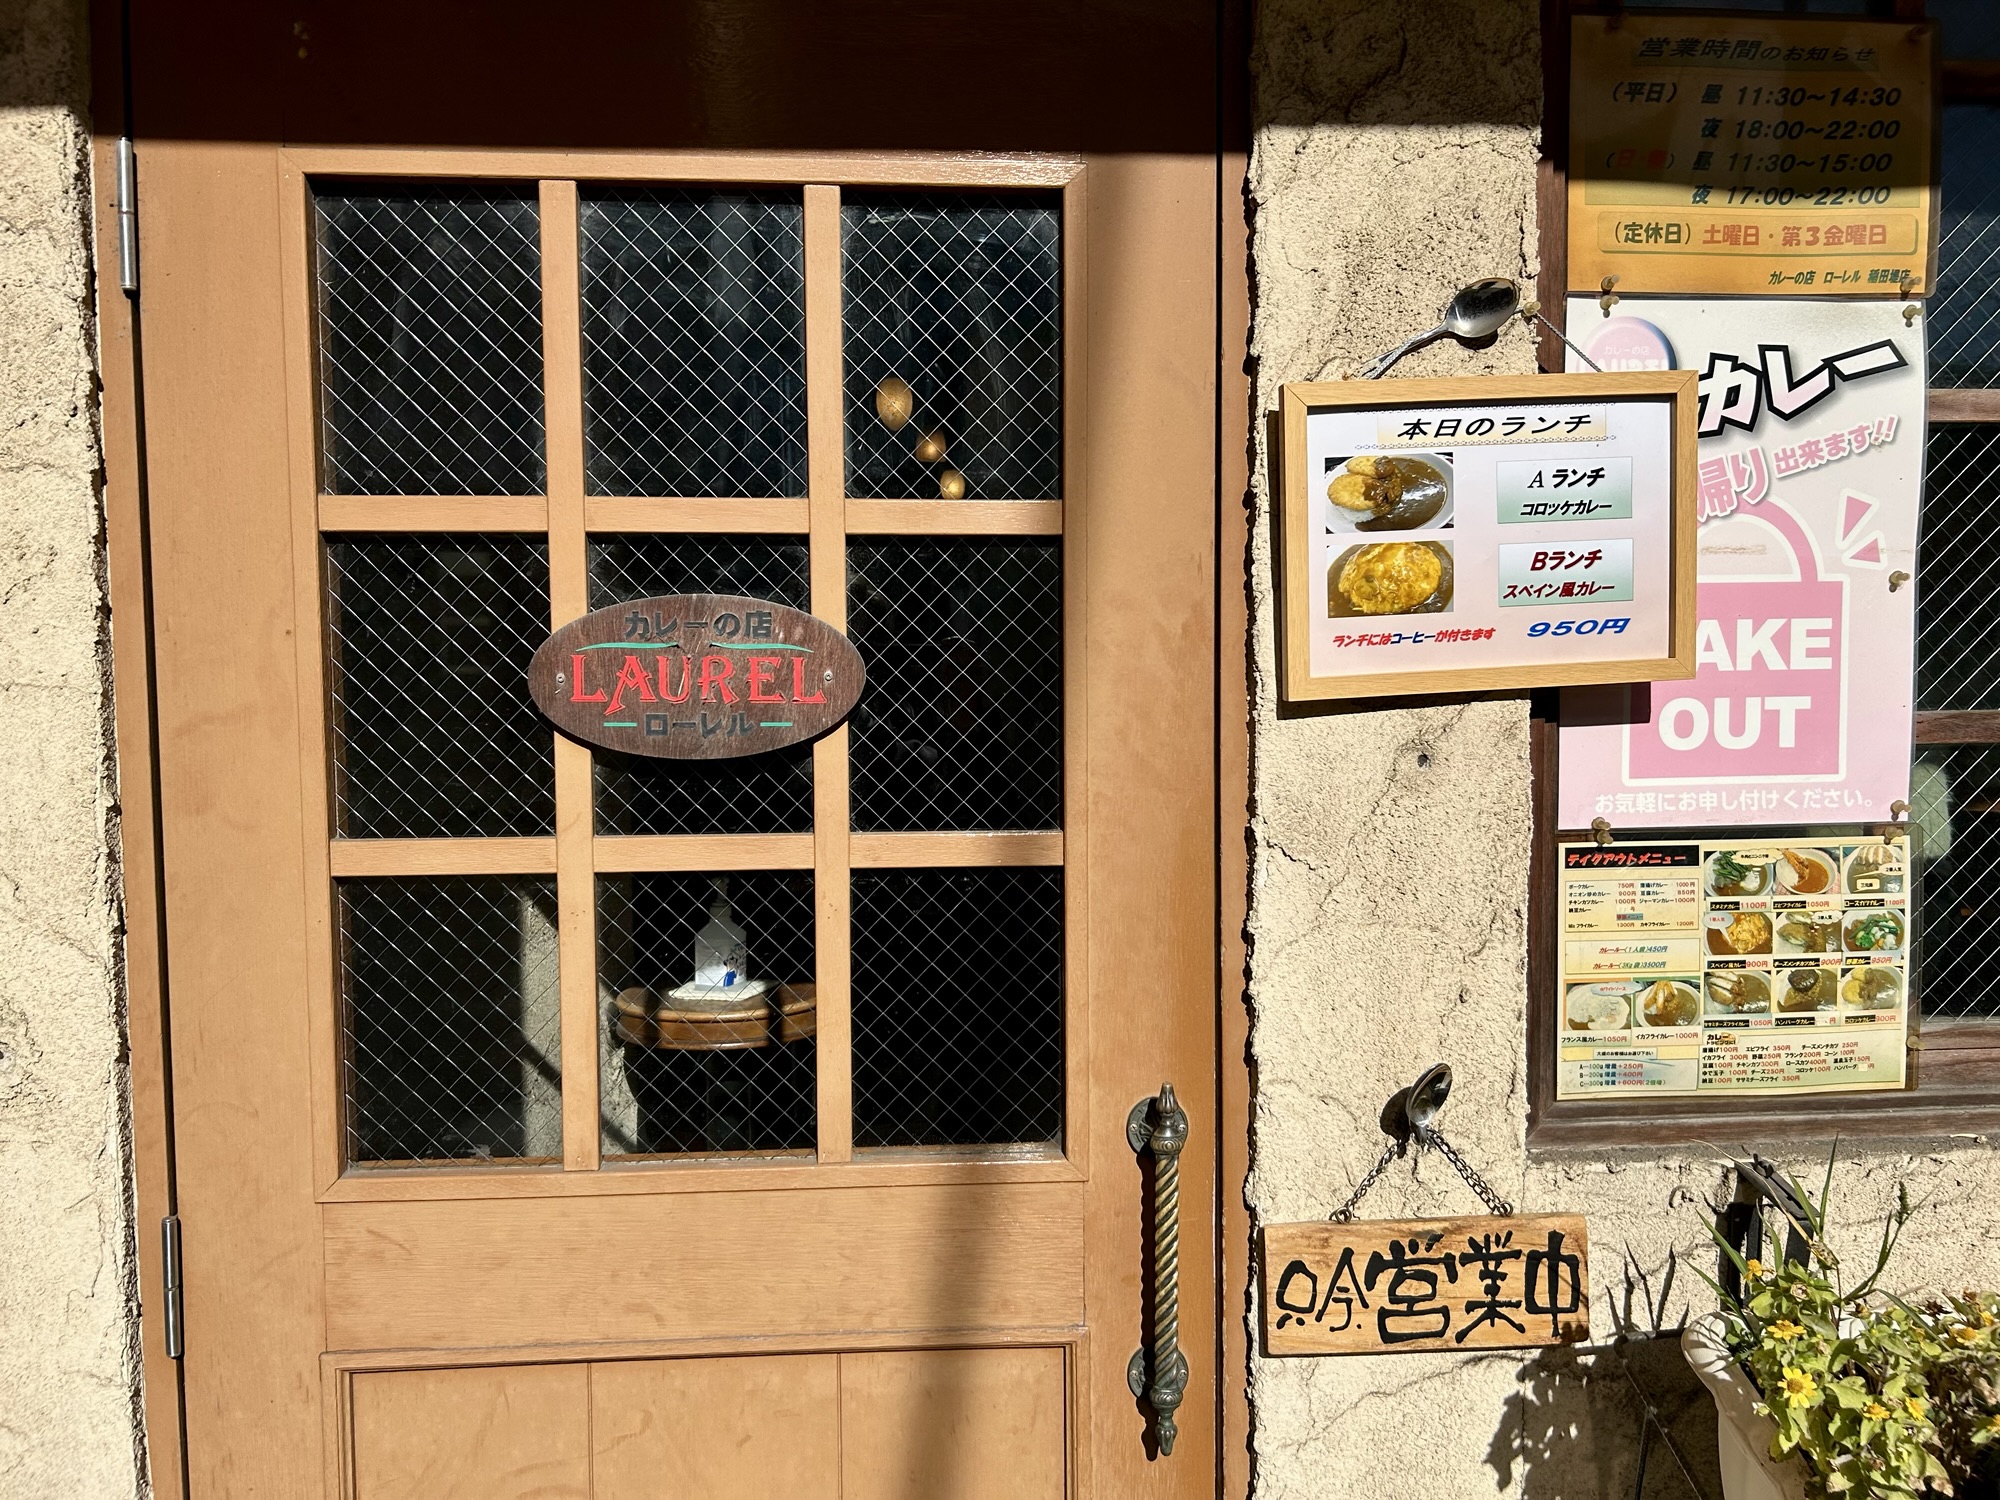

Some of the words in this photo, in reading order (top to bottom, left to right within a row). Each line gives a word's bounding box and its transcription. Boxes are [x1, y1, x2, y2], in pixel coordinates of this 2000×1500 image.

[1637, 37, 1876, 61] 営業時間のお知らせ
[1612, 82, 1678, 103] （平日）
[1701, 84, 1721, 104] 昼
[1738, 86, 1900, 107] 11:30～14:30
[1700, 118, 1718, 139] 夜
[1735, 119, 1900, 140] 18:00～22:00
[1693, 151, 1712, 171] 昼
[1728, 153, 1892, 173] 11:30～15:00
[1690, 184, 1709, 205] 夜
[1726, 185, 1890, 206] 17:00～22:00
[1614, 222, 1691, 245] （定休日）
[1702, 223, 1887, 247] 土曜日・第3金曜日
[1768, 270, 1816, 285] カレーの店
[1823, 270, 1861, 284] ローレル
[1603, 345, 1651, 356] カレーの店
[1698, 338, 1909, 438] カレー
[1397, 415, 1592, 440] 本日のランチ
[1527, 470, 1545, 488] A
[1551, 466, 1606, 488] ランチ
[1697, 445, 1769, 522] 帰り
[1774, 416, 1898, 477] 出来ます!!
[1519, 500, 1612, 517] コロッケカレー
[1530, 550, 1603, 572] Bランチ
[1503, 582, 1615, 600] スペイン風カレー
[624, 610, 774, 639] カレーの店
[1527, 618, 1631, 637] 950円
[1332, 627, 1496, 647] ランチにはコーヒーが付きます
[1696, 618, 1833, 672] AKE
[570, 654, 828, 716] LAUREL
[645, 713, 755, 738] ローレル
[1658, 696, 1811, 751] OUT
[1595, 786, 1874, 814] お気軽にお申し付けください。
[1567, 852, 1686, 866] テイクアウトメニュー
[1741, 901, 1767, 909] 1100円
[1807, 900, 1830, 908] 1050円
[1845, 899, 1884, 907] ロースカツカレー
[1276, 1230, 1580, 1344] 只今営業中
